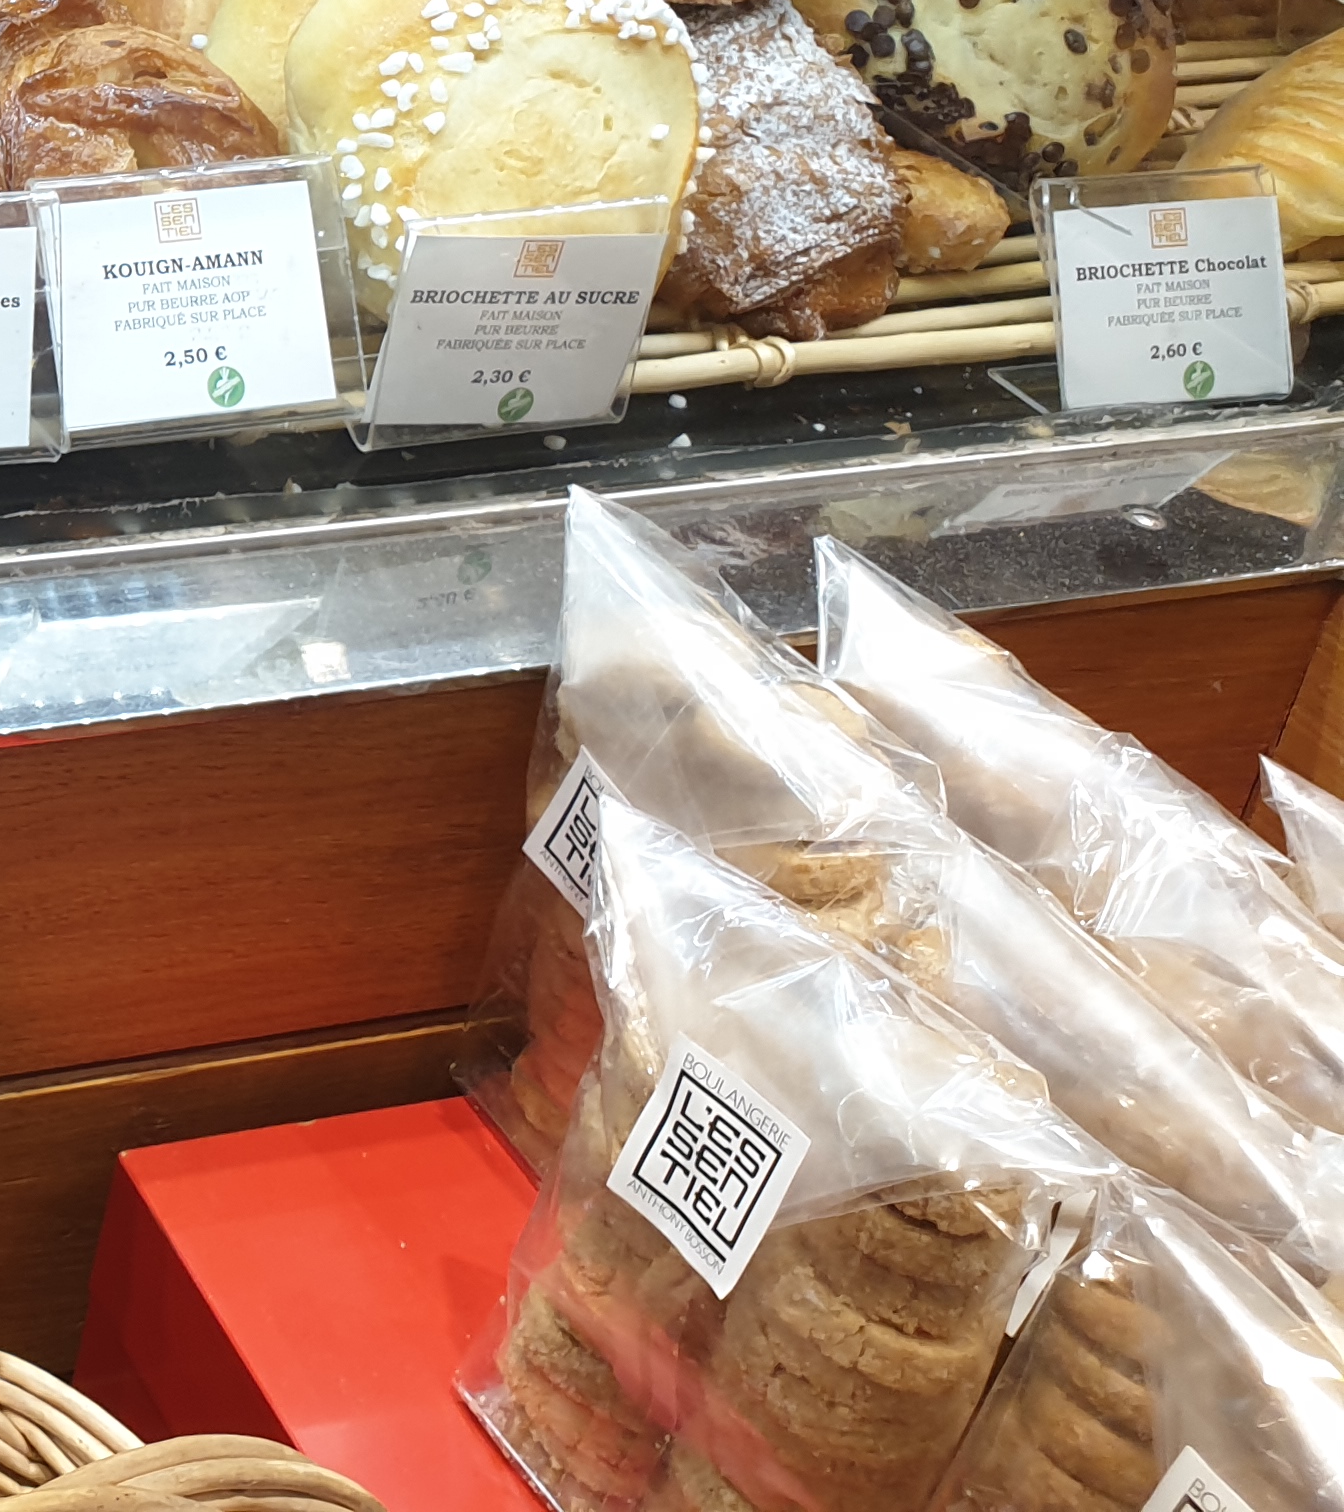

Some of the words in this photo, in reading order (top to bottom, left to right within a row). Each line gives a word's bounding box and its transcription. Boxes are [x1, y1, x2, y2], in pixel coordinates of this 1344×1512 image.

[102, 249, 263, 280] KOUIGN-AMANN
[1075, 259, 1190, 282] BRIOCHETTE
[1194, 254, 1268, 273] Chocolat
[409, 289, 540, 305] BRIOCHETTE
[543, 290, 572, 305] AU
[574, 290, 640, 305] SUCRE
[163, 347, 208, 369] 2,50
[214, 345, 228, 361] €
[1150, 343, 1187, 362] 2,60
[1191, 341, 1203, 356] €
[470, 369, 514, 387] 2,30
[518, 369, 532, 383] €
[682, 1052, 792, 1152] BOULANGERIE
[626, 1179, 687, 1234] ANTHONY
[685, 1224, 726, 1276] BOSSON
